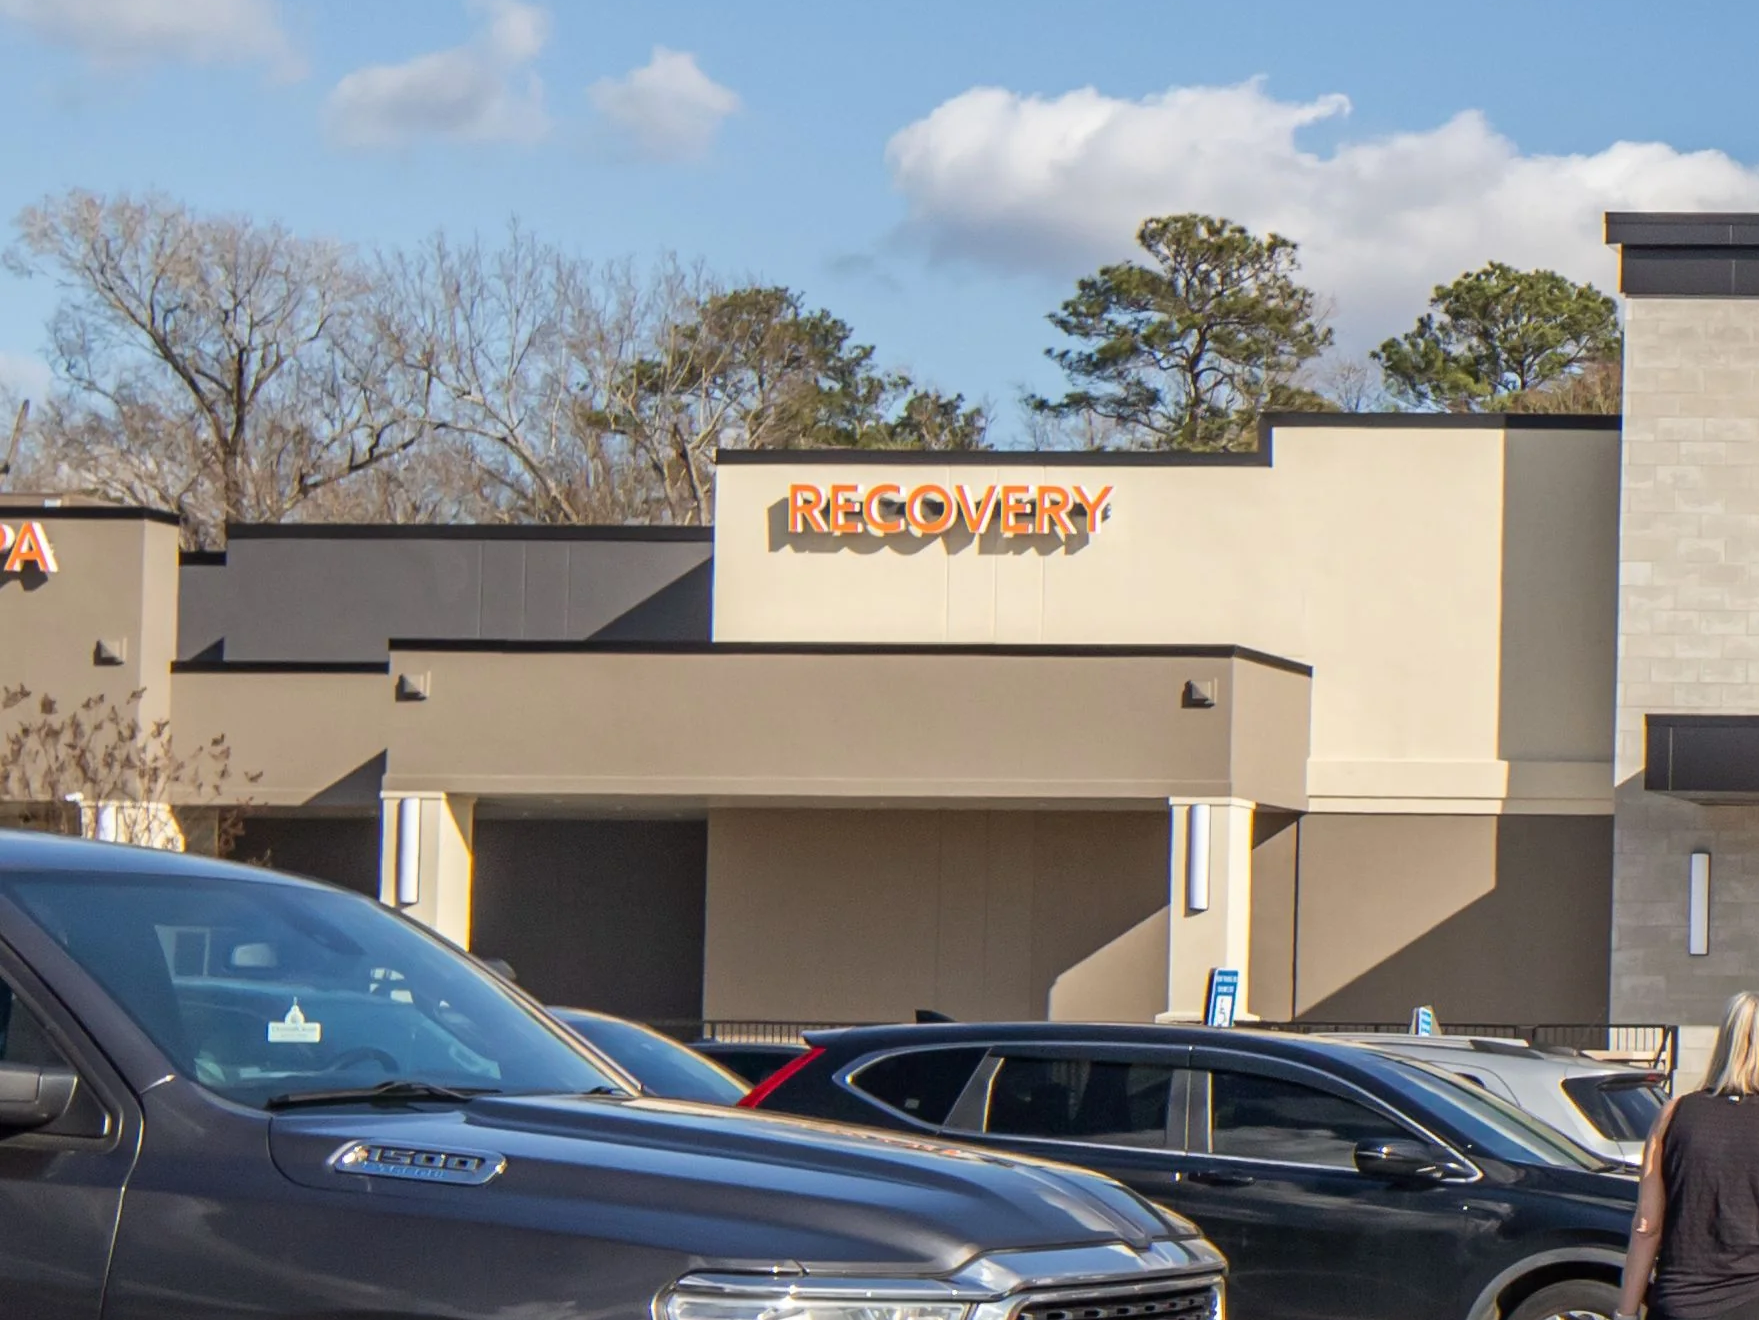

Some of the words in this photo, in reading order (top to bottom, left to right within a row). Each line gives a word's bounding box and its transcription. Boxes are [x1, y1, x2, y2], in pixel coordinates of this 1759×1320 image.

[787, 482, 1114, 536] RECOVERY
[0, 521, 59, 573] A
[369, 1146, 485, 1173] 1500
